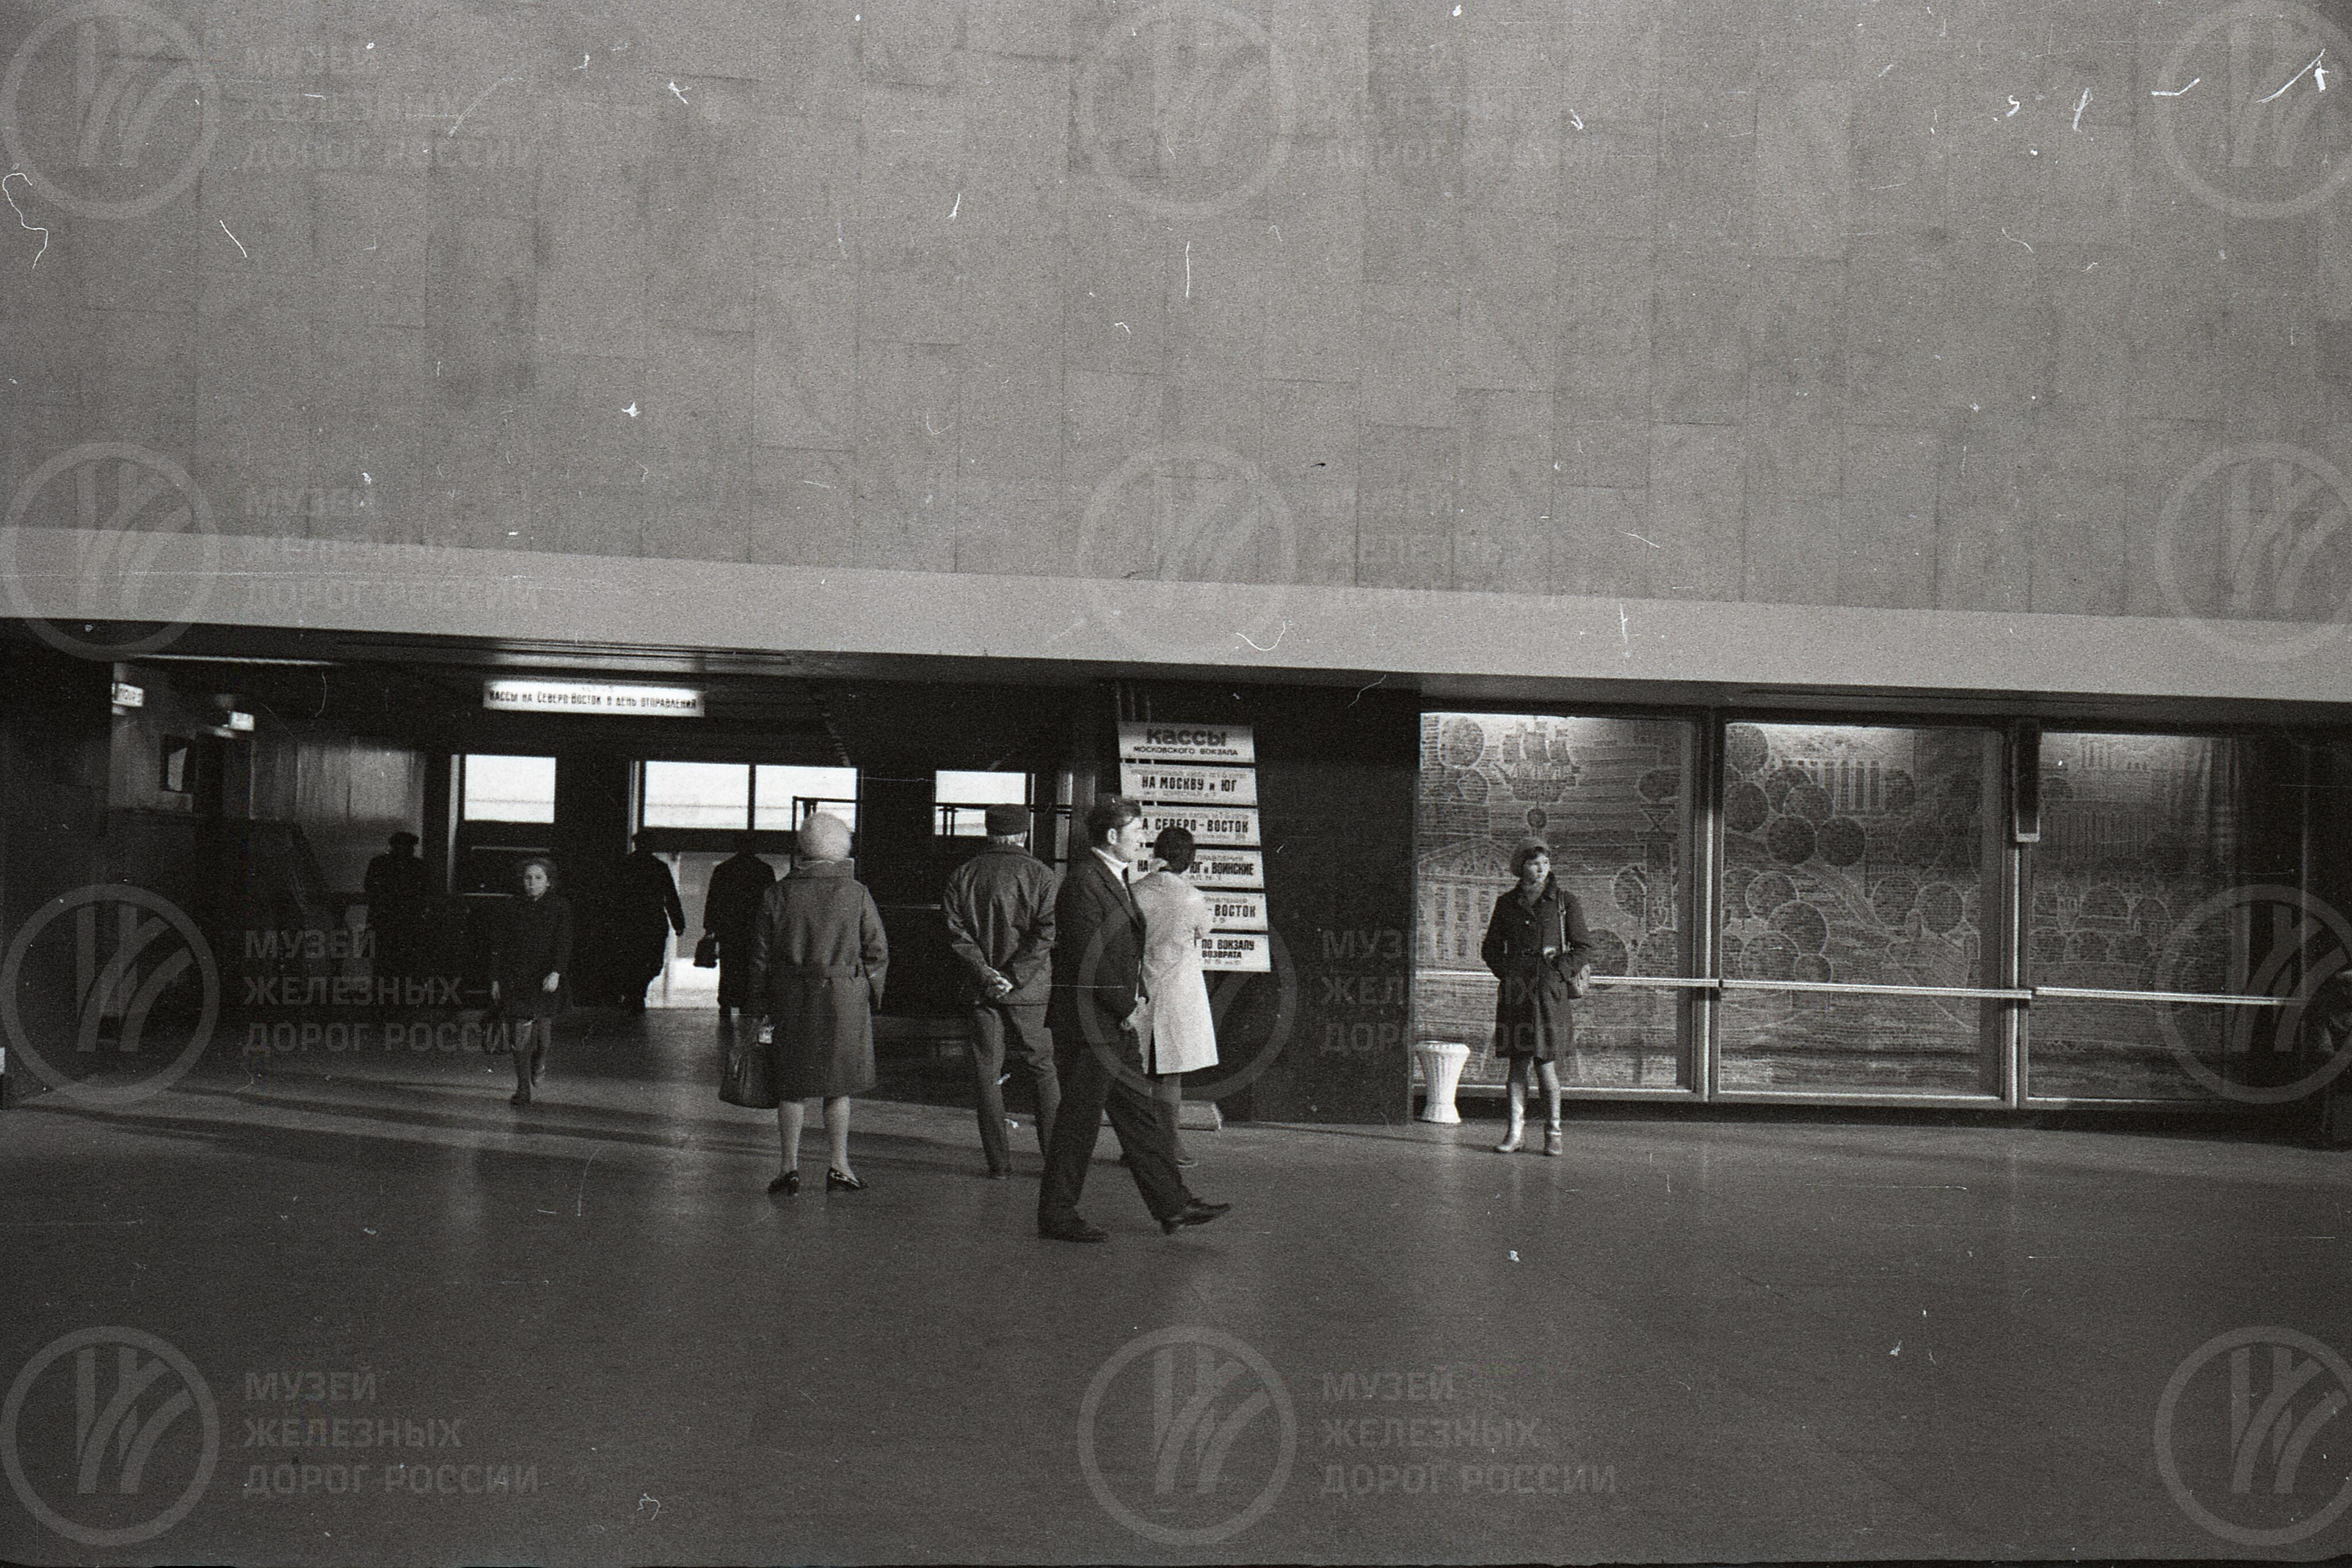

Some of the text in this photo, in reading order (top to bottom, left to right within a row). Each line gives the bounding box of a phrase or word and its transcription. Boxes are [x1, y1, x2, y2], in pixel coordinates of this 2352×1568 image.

[1134, 746, 1238, 756] МОСКОВСКОГО ВОКЗАЛА
[1142, 777, 1155, 789] НА
[1160, 777, 1204, 791] МОСКВУ
[1221, 779, 1237, 792] ЮГ
[1142, 818, 1148, 830] А
[1138, 860, 1148, 872] НА
[1212, 862, 1254, 876] ВОИНСКИЕ
[1202, 939, 1254, 951] ПО ВОКЗАЛУ
[1202, 950, 1242, 959] ВОЗВРАТА
